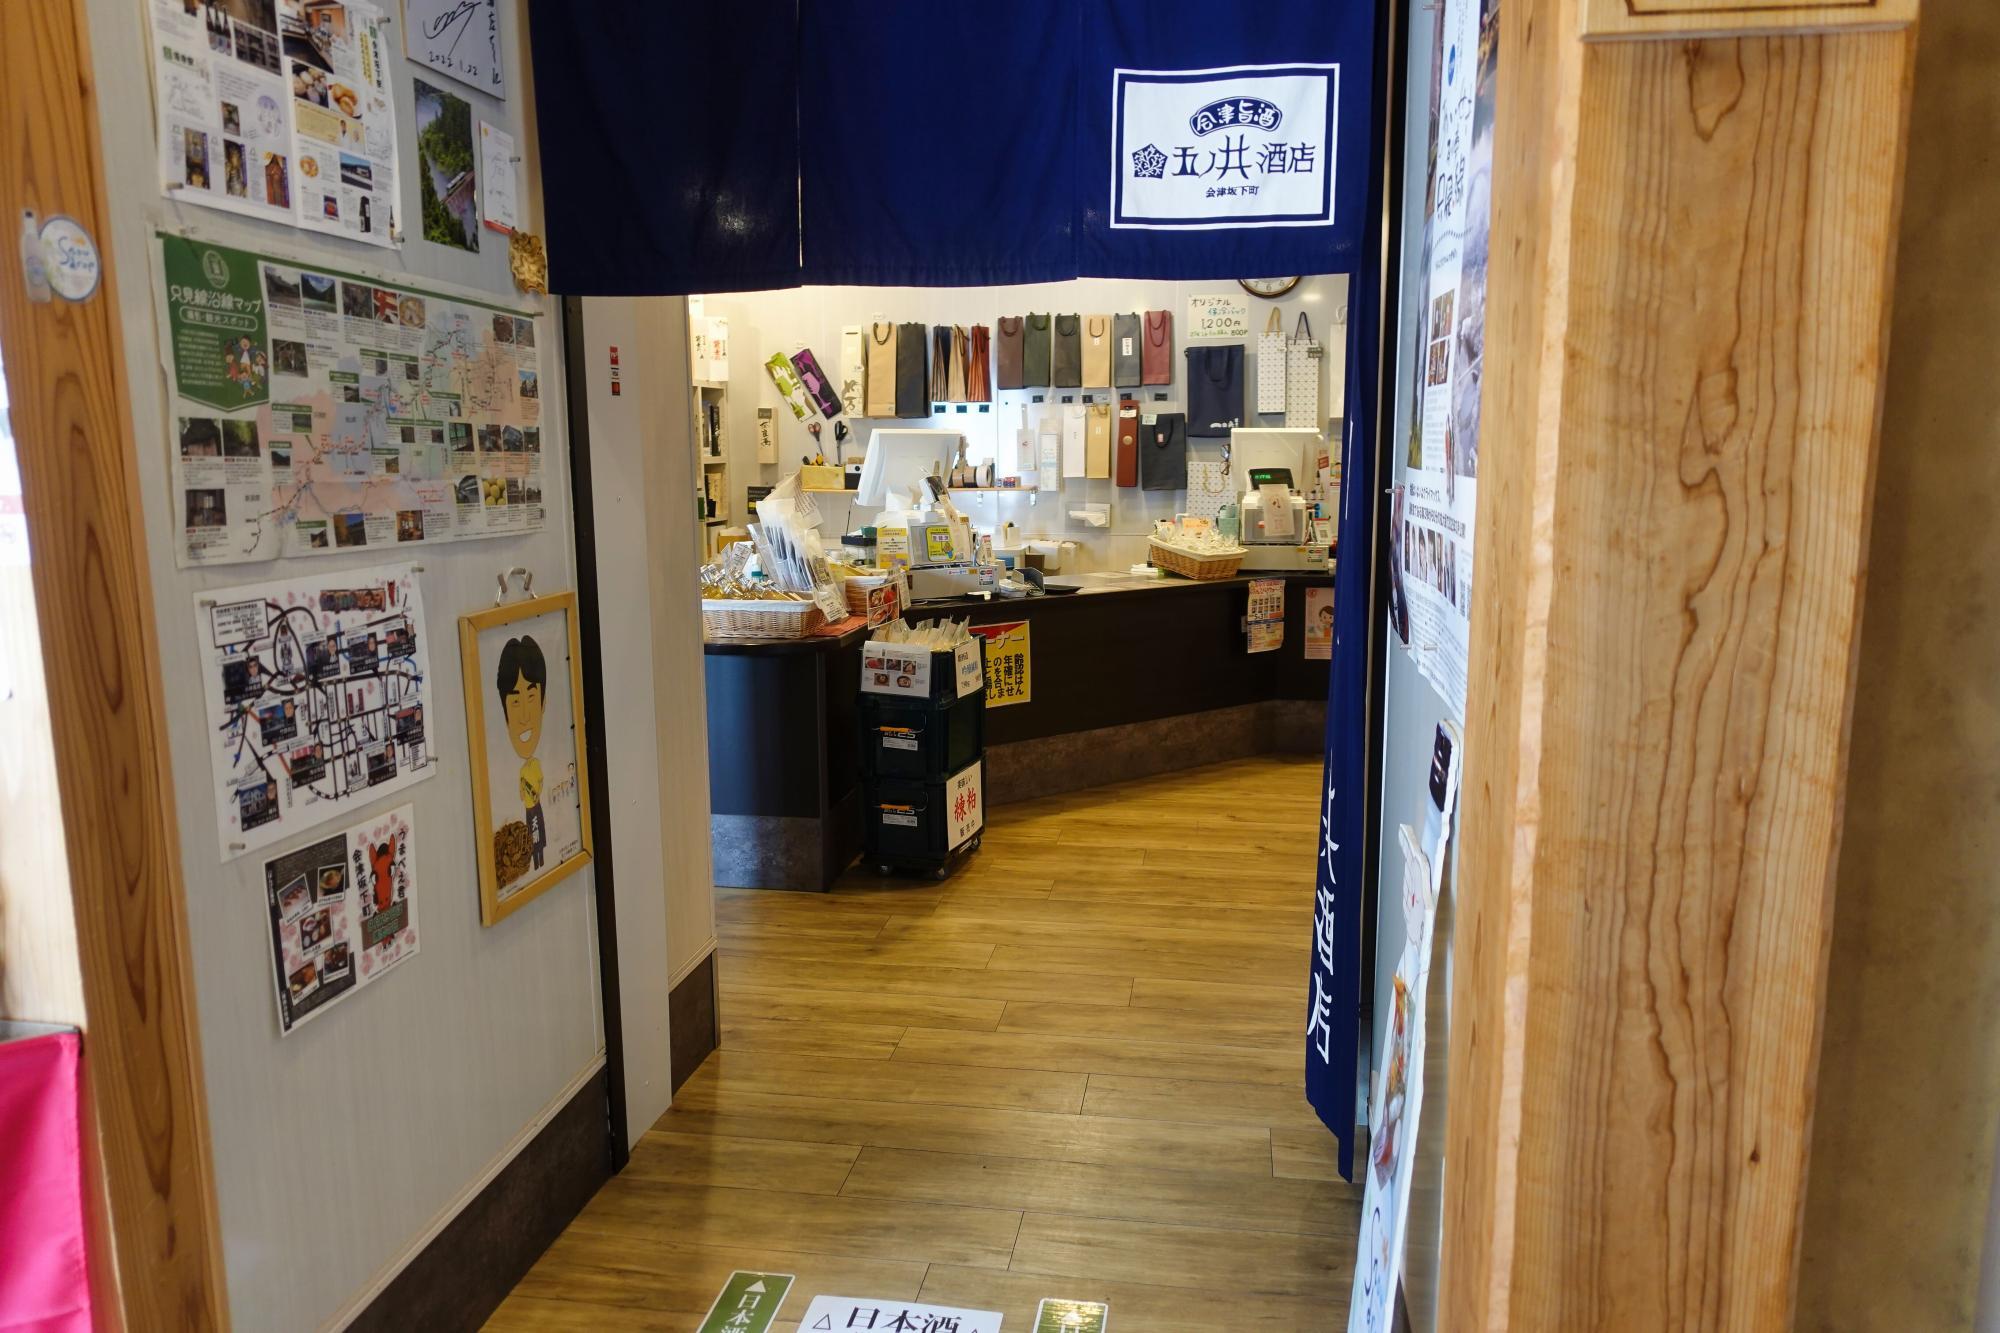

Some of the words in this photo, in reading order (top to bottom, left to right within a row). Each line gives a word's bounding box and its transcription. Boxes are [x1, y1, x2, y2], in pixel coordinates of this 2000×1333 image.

[1172, 133, 1316, 181] 五ノ井酒店
[1205, 185, 1260, 198] 会津坂下町
[1191, 298, 1231, 307] オリジナル
